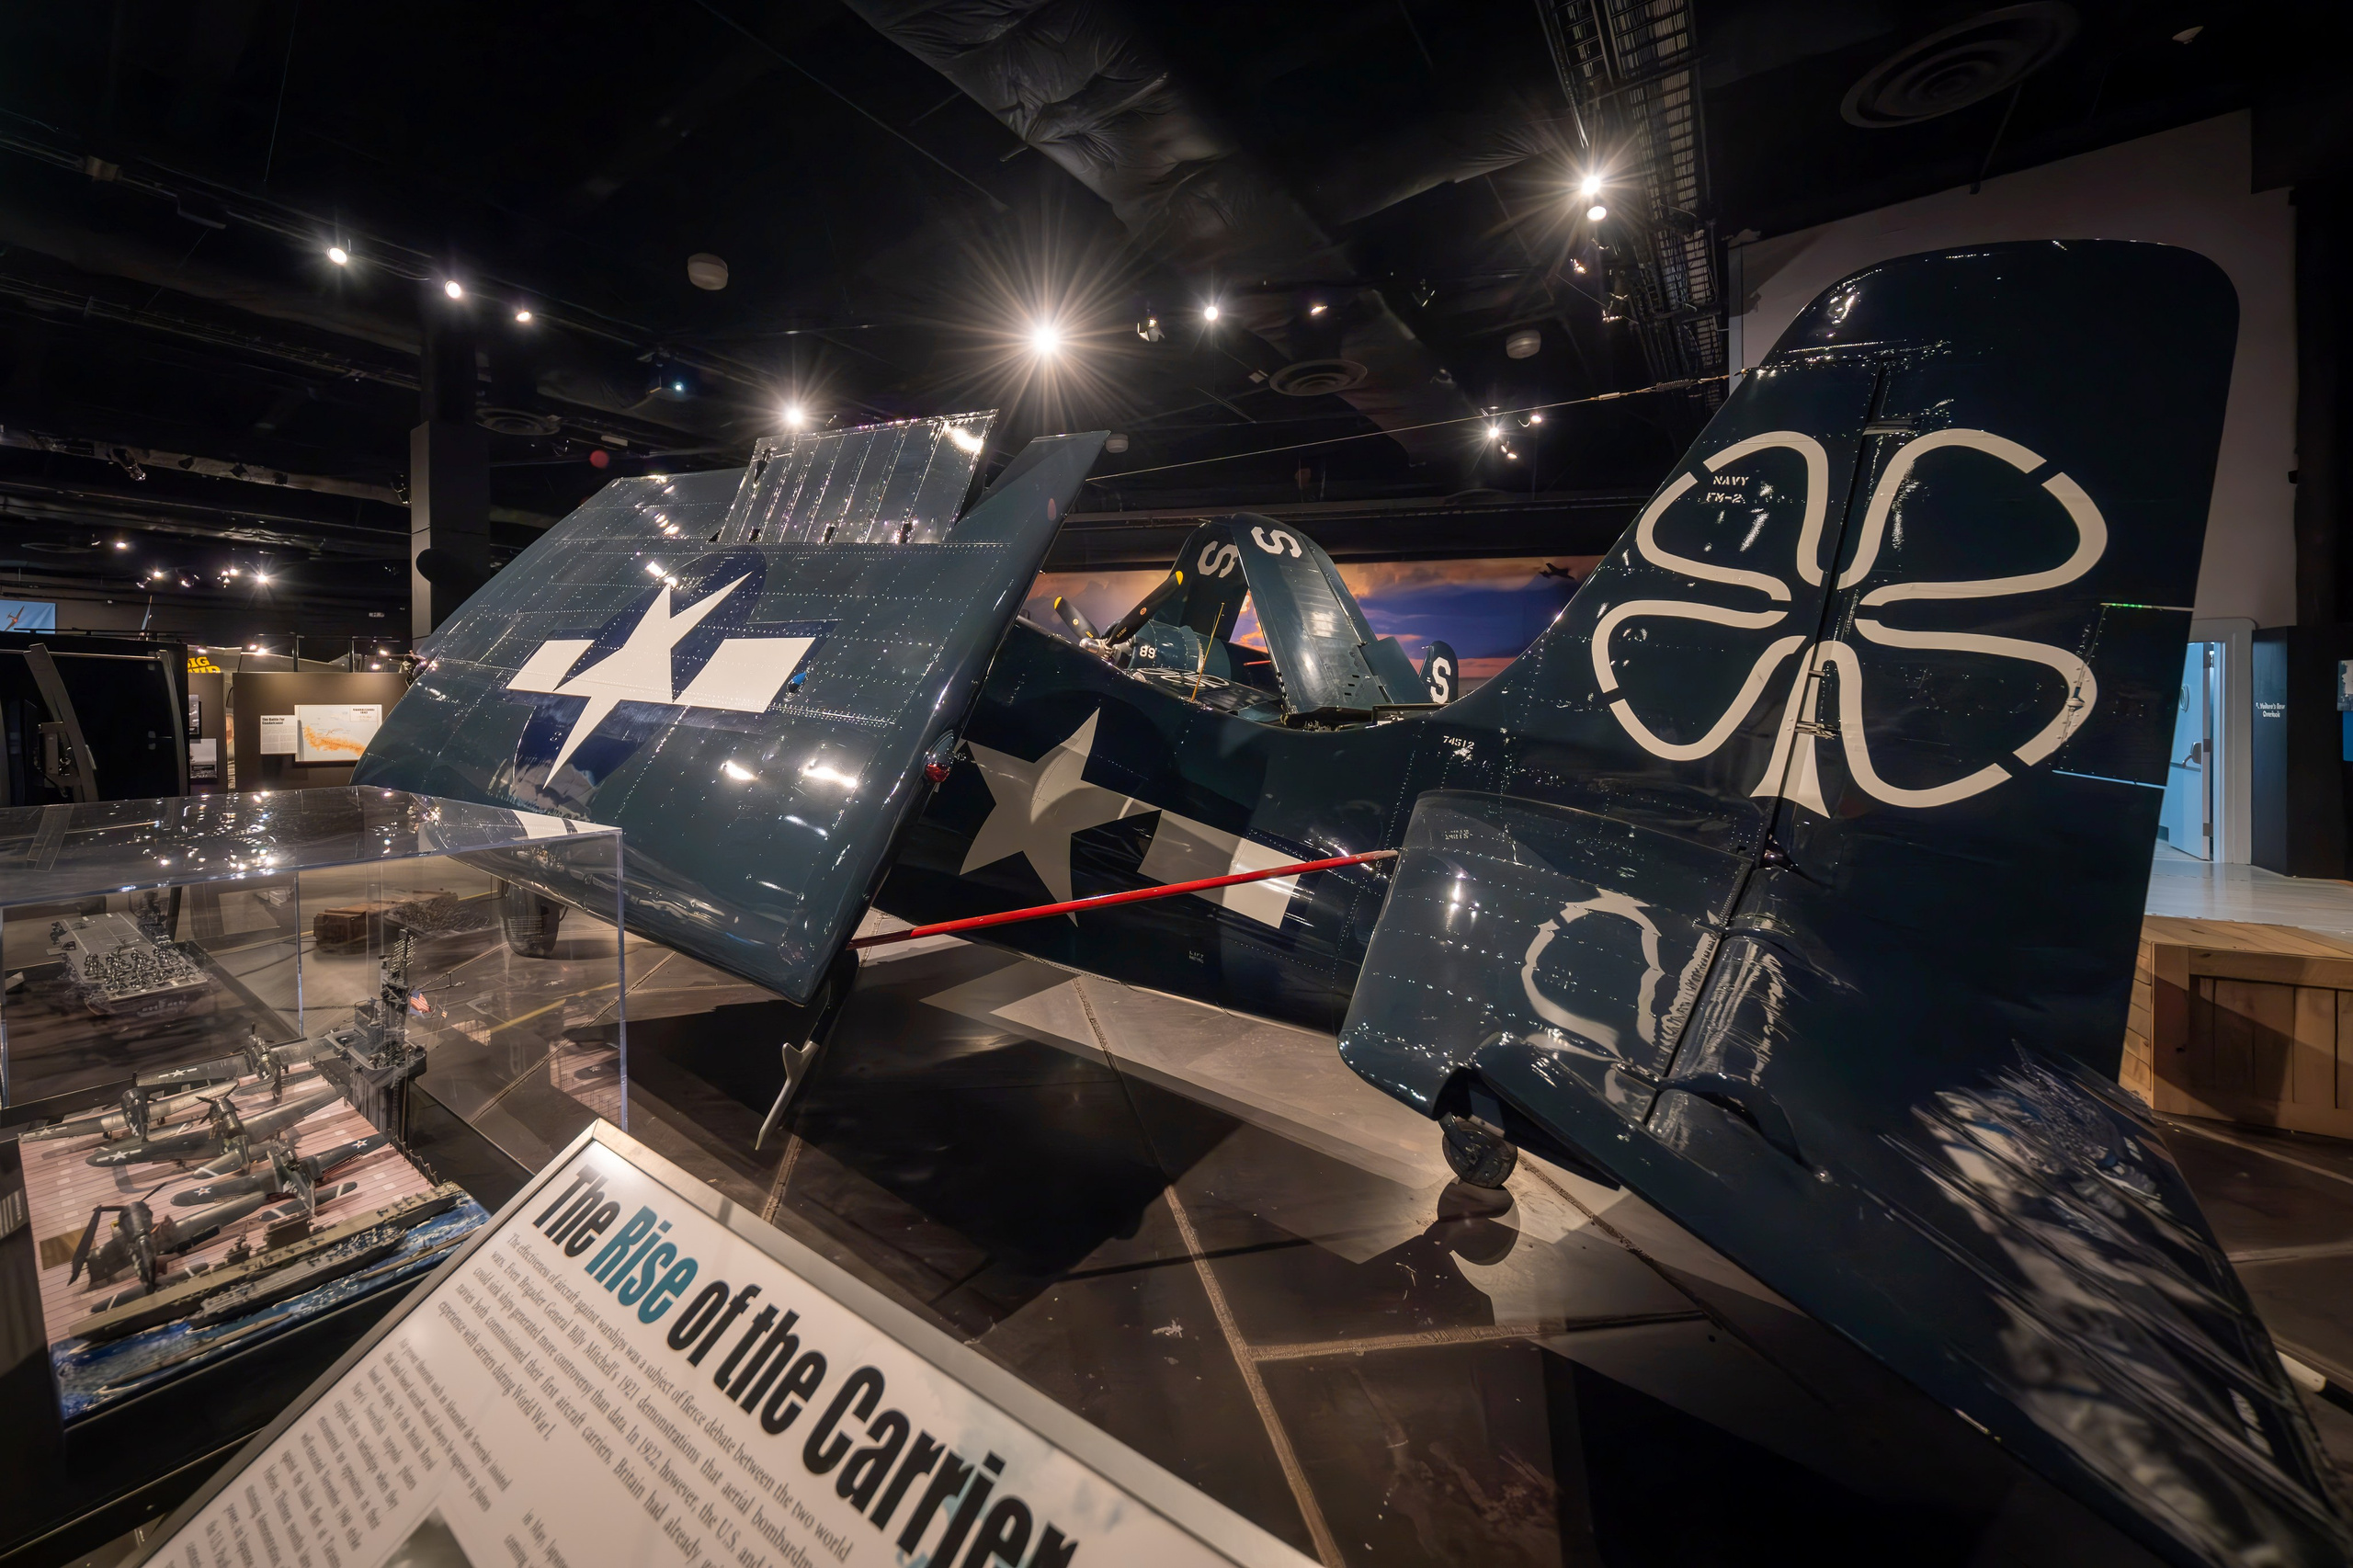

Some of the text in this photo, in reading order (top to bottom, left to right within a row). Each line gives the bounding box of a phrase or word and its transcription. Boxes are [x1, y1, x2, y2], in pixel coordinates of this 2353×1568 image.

[1706, 492, 1743, 504] FM-2
[1712, 475, 1750, 486] NAVY
[1251, 526, 1302, 559] S
[1430, 656, 1451, 705] S
[1443, 735, 1475, 750] 74512
[532, 1164, 620, 1257] The
[584, 1205, 699, 1324] Rise
[438, 1301, 467, 1334] experience
[461, 1328, 481, 1348] with
[472, 1342, 497, 1371] carriers
[491, 1362, 516, 1397] during
[511, 1383, 540, 1417] World
[530, 1406, 550, 1434] War
[667, 1279, 763, 1368] of
[713, 1302, 827, 1436] the
[455, 1283, 701, 1564] navies both commissioned their first aircraft carriers. Britain had already
[472, 1267, 495, 1287] could
[486, 1279, 505, 1298] sink
[496, 1290, 516, 1312] ships
[506, 1307, 545, 1340] generated
[536, 1335, 558, 1358] more
[553, 1353, 595, 1398] controversy
[589, 1388, 610, 1415] than
[606, 1406, 628, 1435] data.
[625, 1424, 640, 1447] In
[636, 1437, 663, 1471] 1922,
[657, 1458, 699, 1513] however,
[698, 1502, 719, 1529] the
[715, 1517, 741, 1553] U.S.
[490, 1250, 506, 1268] wars.
[503, 1261, 521, 1282] Even
[517, 1276, 547, 1307] Brigadier
[543, 1301, 574, 1332] General
[566, 1324, 587, 1349] Billy
[583, 1340, 620, 1381] Mitchell's
[617, 1375, 641, 1402] 1921
[636, 1395, 700, 1464] demonstrations
[699, 1458, 723, 1486] that
[721, 1482, 756, 1516] aerial
[506, 1233, 854, 1564] The effectiveness of aircraft against warships was a subject of fierce debate between the two world
